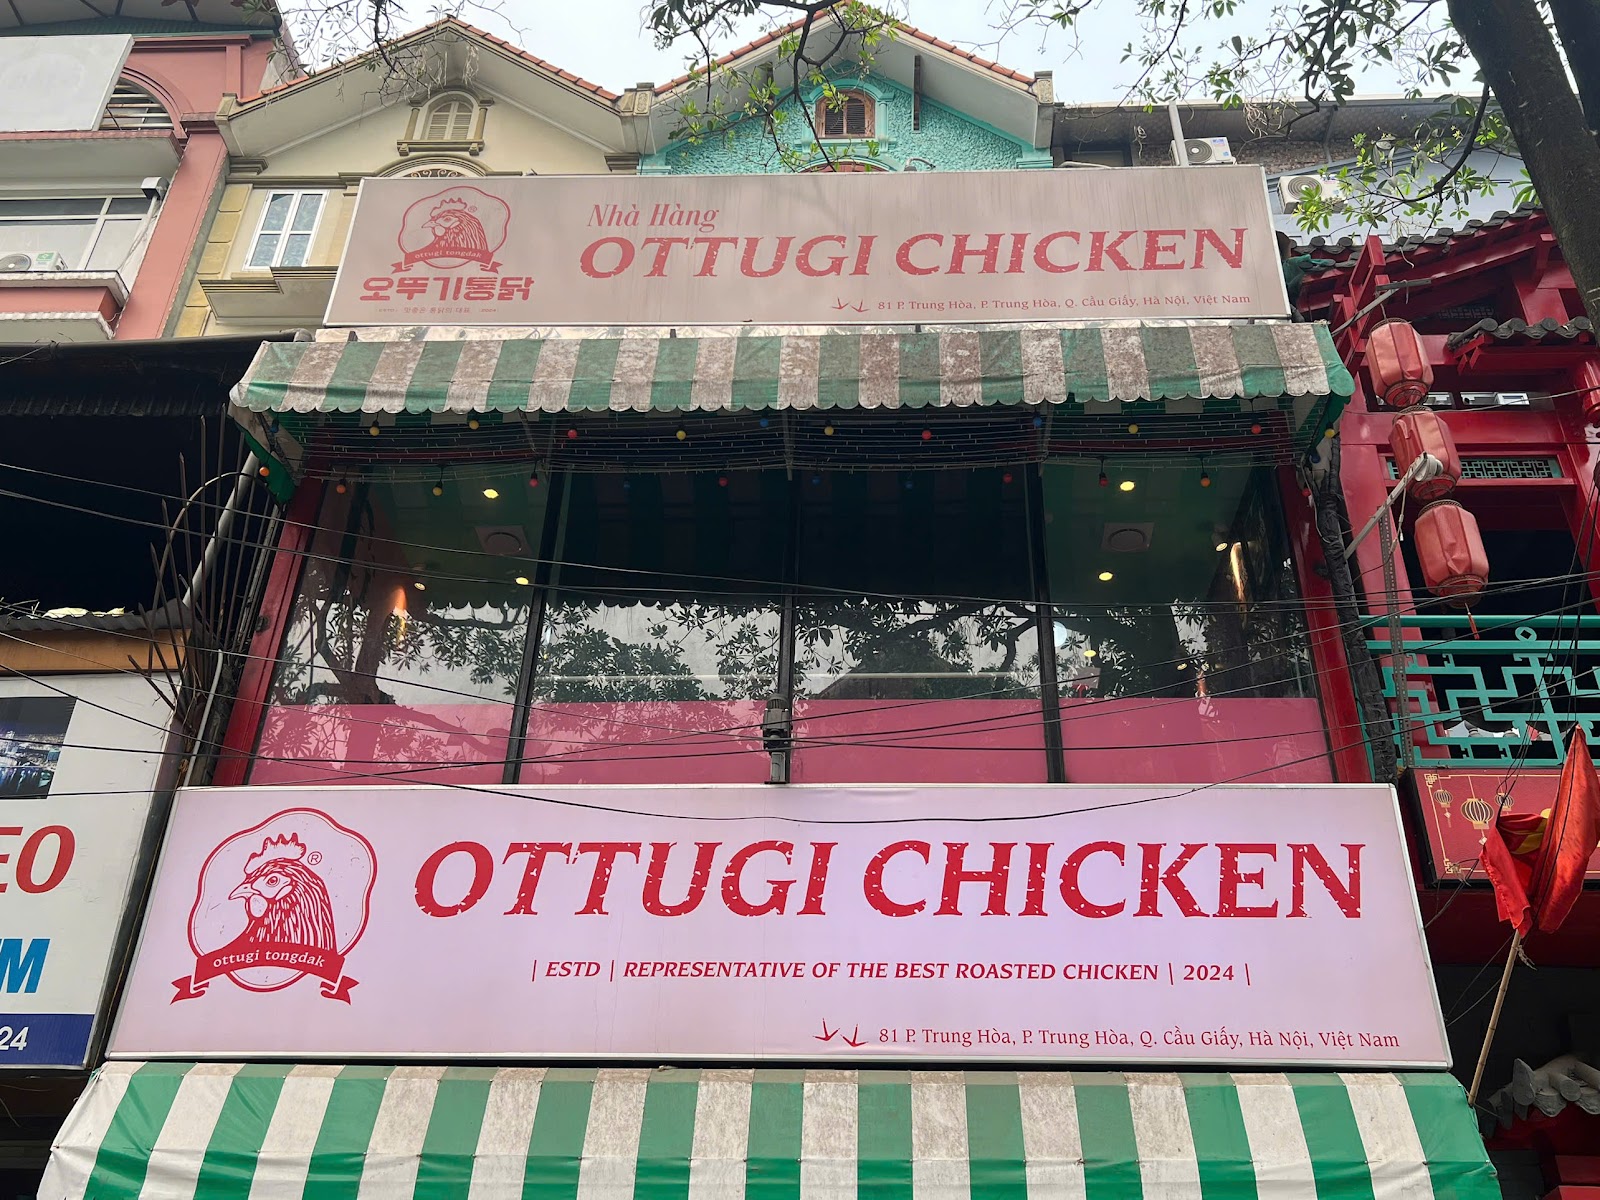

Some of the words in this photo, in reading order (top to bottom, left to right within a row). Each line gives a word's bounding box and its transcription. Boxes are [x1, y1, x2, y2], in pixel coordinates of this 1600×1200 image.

[587, 203, 640, 227] Nhà
[648, 203, 719, 232] Hàng
[414, 250, 443, 259] ottugi
[445, 250, 482, 259] tongdak
[580, 234, 876, 279] OTTUGI
[896, 228, 1248, 276] CHICKEN
[360, 277, 534, 301] 오뚜기통닭
[878, 301, 893, 310] 81
[908, 300, 945, 311] Trung
[948, 300, 976, 311] Hòa,
[993, 300, 1029, 311] Trung
[1033, 298, 1061, 310] Hòa,
[1065, 298, 1078, 309] Q.
[1081, 294, 1105, 307] Cầu
[1108, 295, 1139, 309] Giấy,
[1143, 296, 1160, 306] Hà
[1164, 295, 1190, 307] Nội,
[1194, 295, 1219, 306] Việt
[1222, 295, 1251, 304] Nam
[414, 840, 838, 918] OTTUGI
[863, 840, 1366, 918] CHICKEN
[213, 949, 260, 968] ottugi
[265, 949, 325, 968] tongdak
[545, 961, 601, 978] ESTD
[623, 961, 805, 978] REPRESENTATIVE
[812, 962, 841, 978] OF
[847, 962, 887, 978] THE
[895, 963, 949, 979] BEST
[955, 963, 1056, 980] ROASTED
[1063, 963, 1159, 980] CHICKEN
[1183, 964, 1235, 981] 2024
[879, 1028, 898, 1043] 81
[906, 1028, 916, 1043] P.
[922, 1029, 972, 1047] Trung
[978, 1027, 1016, 1046] Hòa,
[1022, 1029, 1033, 1044] P.
[1039, 1029, 1089, 1048] Trung
[1095, 1028, 1134, 1047] Hòa,
[1139, 1030, 1157, 1047] Q.
[1163, 1026, 1195, 1045] Cầu
[1201, 1026, 1243, 1049] Giấy,
[1249, 1029, 1273, 1046] Hà
[1279, 1031, 1314, 1050] Nội,
[1318, 1031, 1354, 1050] Việt
[1358, 1032, 1400, 1047] Nam
